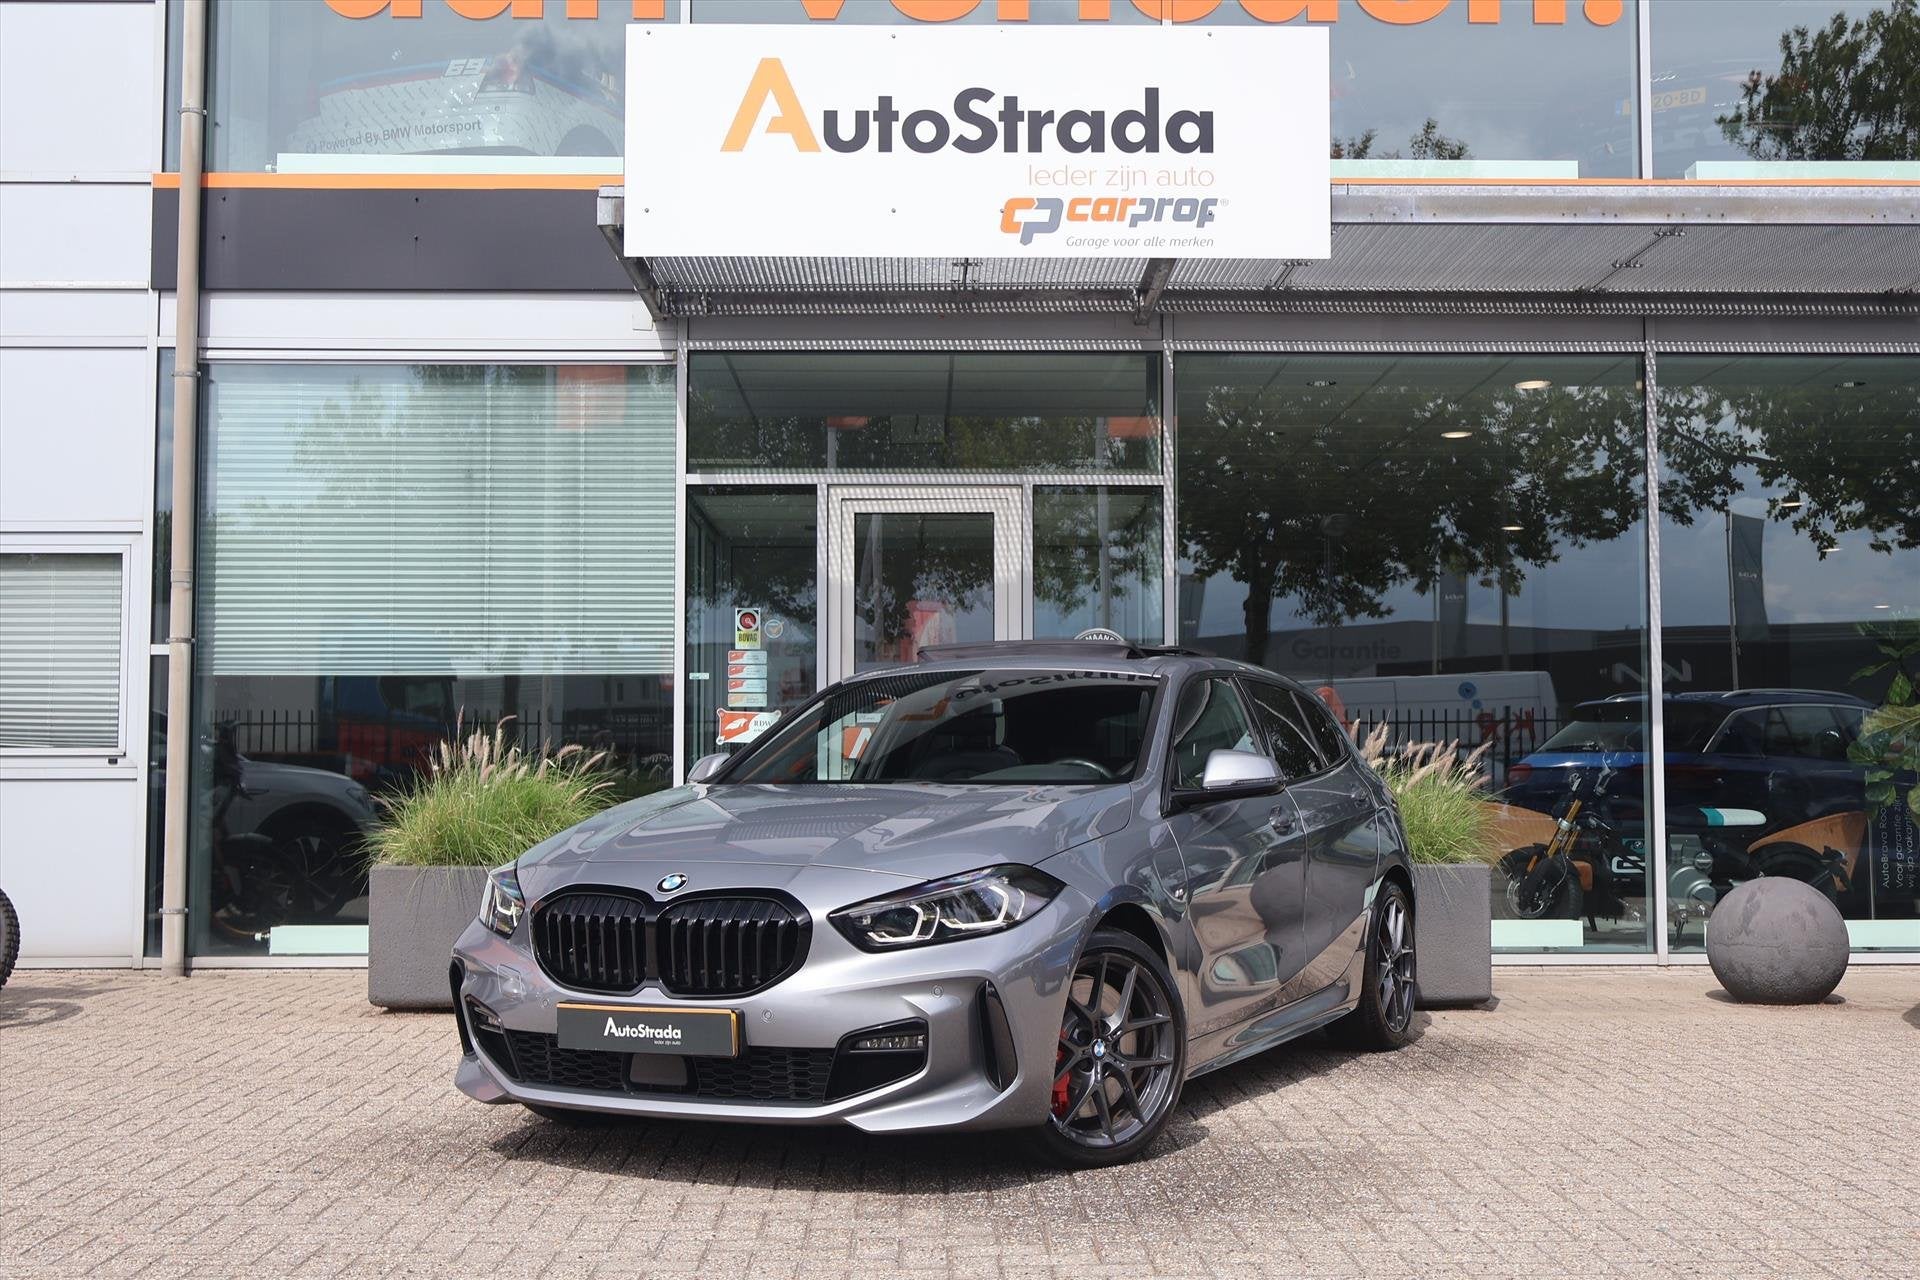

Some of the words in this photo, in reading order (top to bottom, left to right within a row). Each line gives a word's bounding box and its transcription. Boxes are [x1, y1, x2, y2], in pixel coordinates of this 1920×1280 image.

[720, 57, 1214, 154] AutoStrada
[320, 132, 362, 151] Powered
[365, 131, 380, 145] By
[383, 126, 411, 141] BMW
[414, 119, 482, 136] Motorsport
[1028, 164, 1097, 186] Ieder
[1105, 165, 1147, 192] zijn
[1156, 166, 1215, 187] auto
[1066, 235, 1109, 249] Garage
[1113, 237, 1140, 247] voor
[1144, 235, 1166, 247] alle
[1169, 235, 1214, 247] merken
[738, 633, 758, 642] BOVAG
[1291, 637, 1402, 660] Garantie
[1894, 817, 1905, 860] garantie
[1880, 832, 1890, 888] AutoBrava
[1895, 862, 1904, 888] Voor
[603, 1016, 682, 1039] AutoStrada
